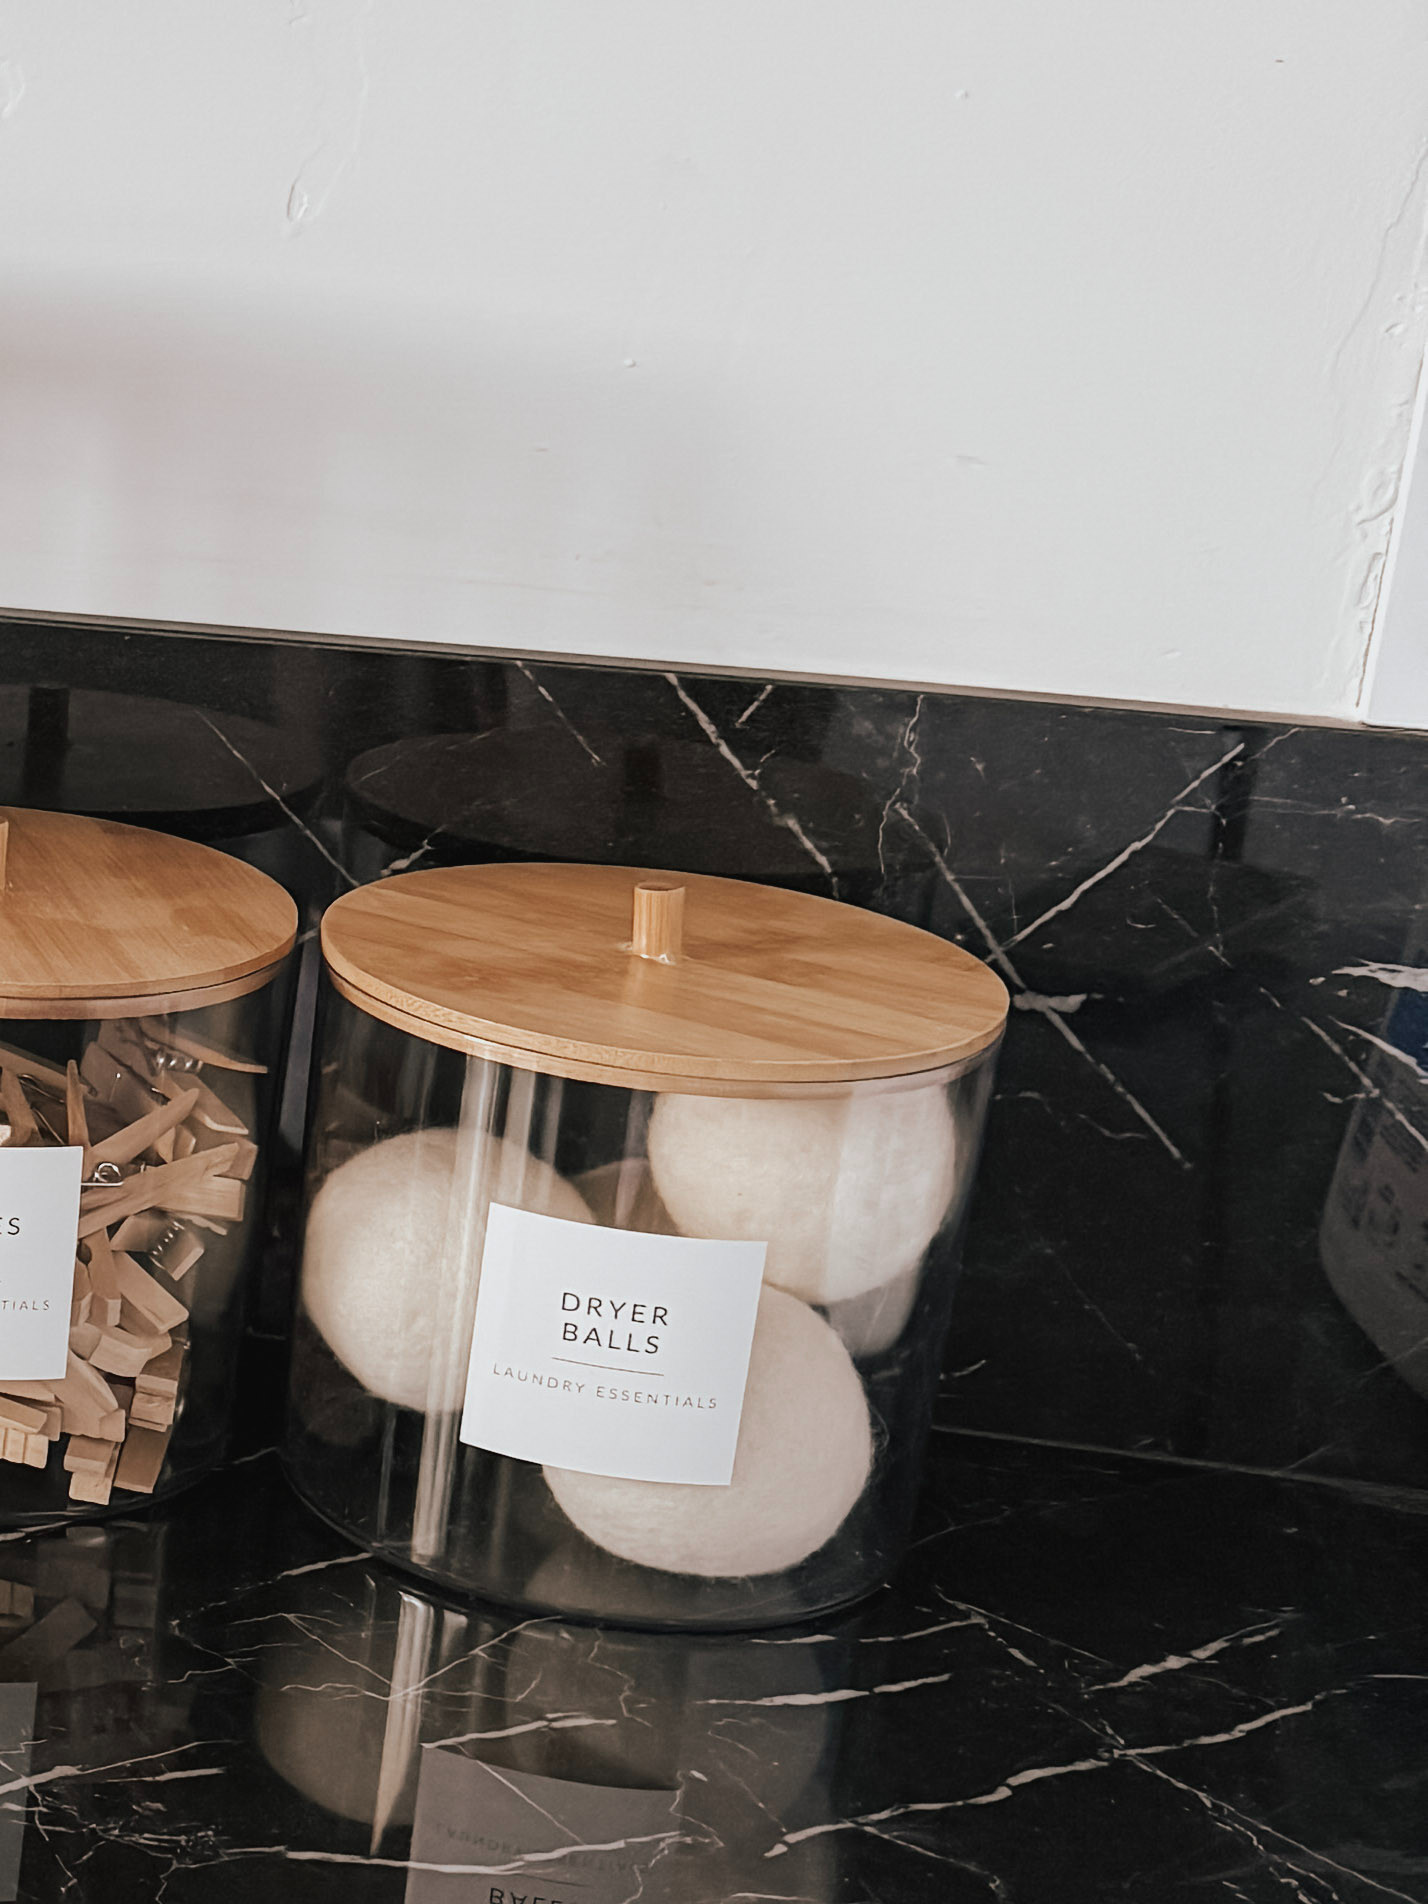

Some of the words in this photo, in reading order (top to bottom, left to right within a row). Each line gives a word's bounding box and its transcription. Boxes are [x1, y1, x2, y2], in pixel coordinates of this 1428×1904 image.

[561, 1291, 669, 1327] DRYER
[562, 1322, 660, 1355] BALLS
[492, 1362, 587, 1394] LAUNDRY
[595, 1385, 718, 1410] ESSENTIALS
